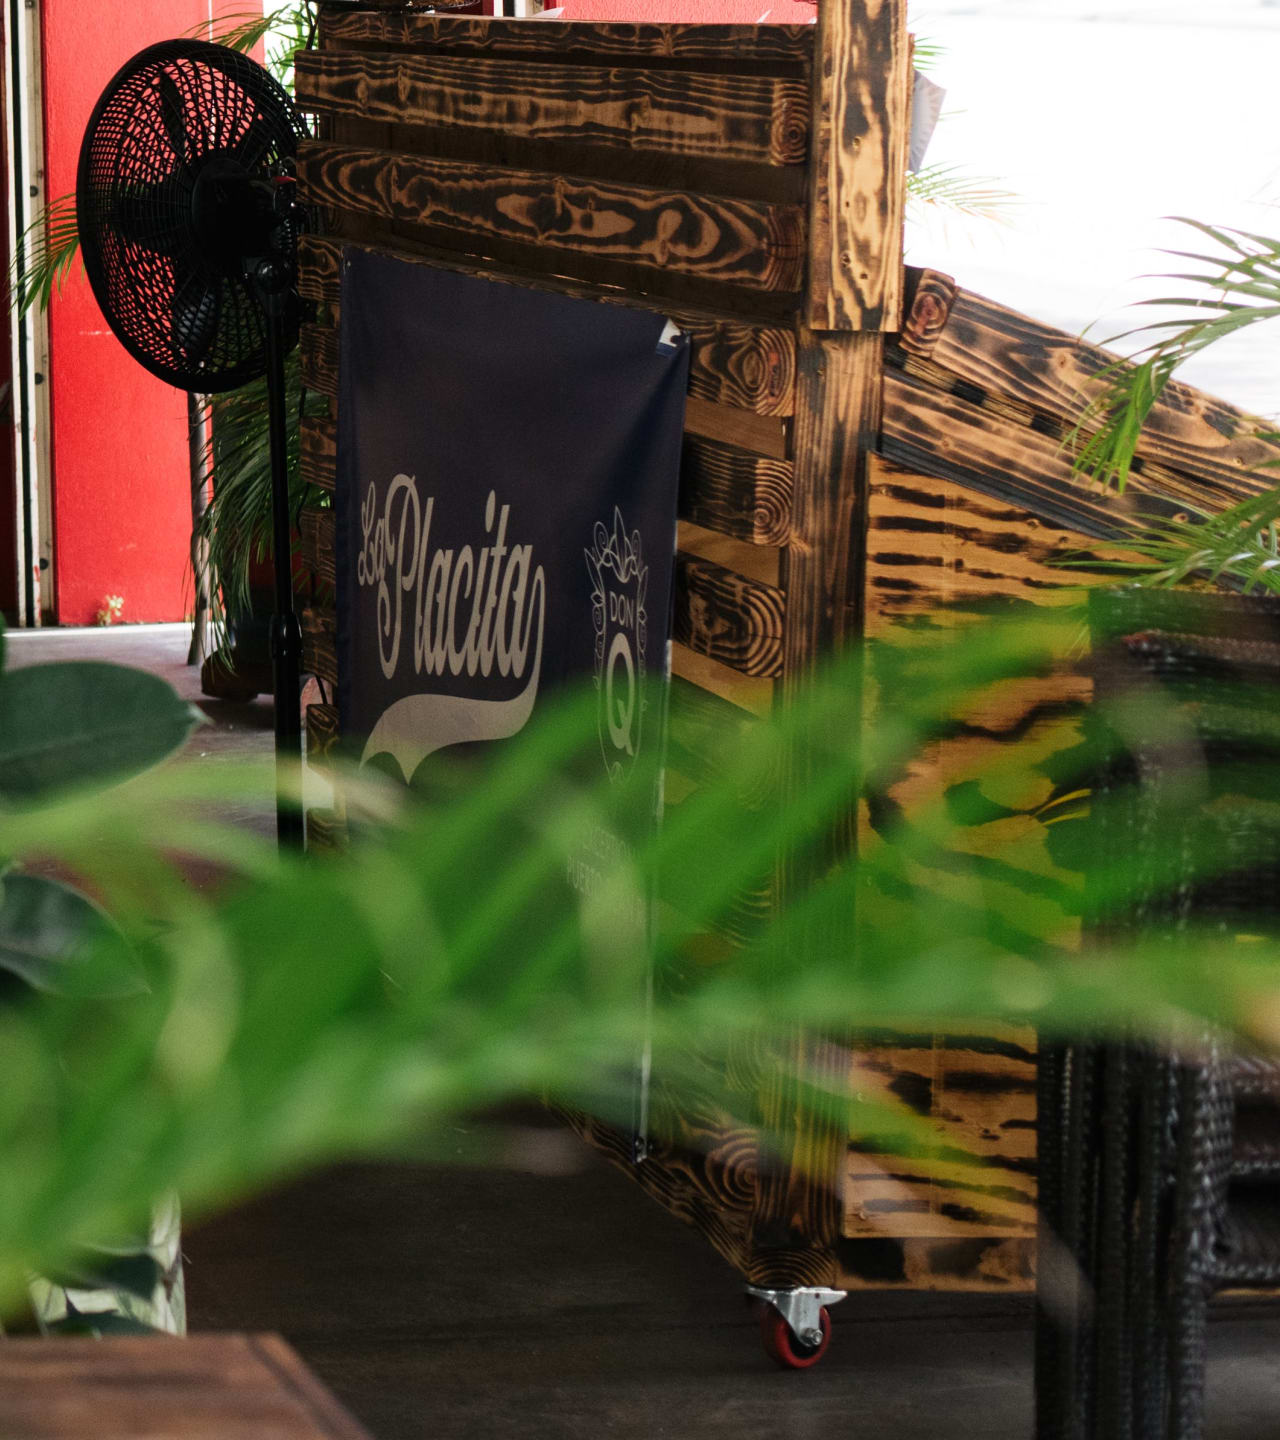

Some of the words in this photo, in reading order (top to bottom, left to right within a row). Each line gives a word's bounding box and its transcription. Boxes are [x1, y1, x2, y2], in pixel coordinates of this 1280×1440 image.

[357, 480, 386, 587] La
[377, 473, 546, 680] Placita
[609, 590, 635, 631] DON
[606, 632, 635, 756] Q
